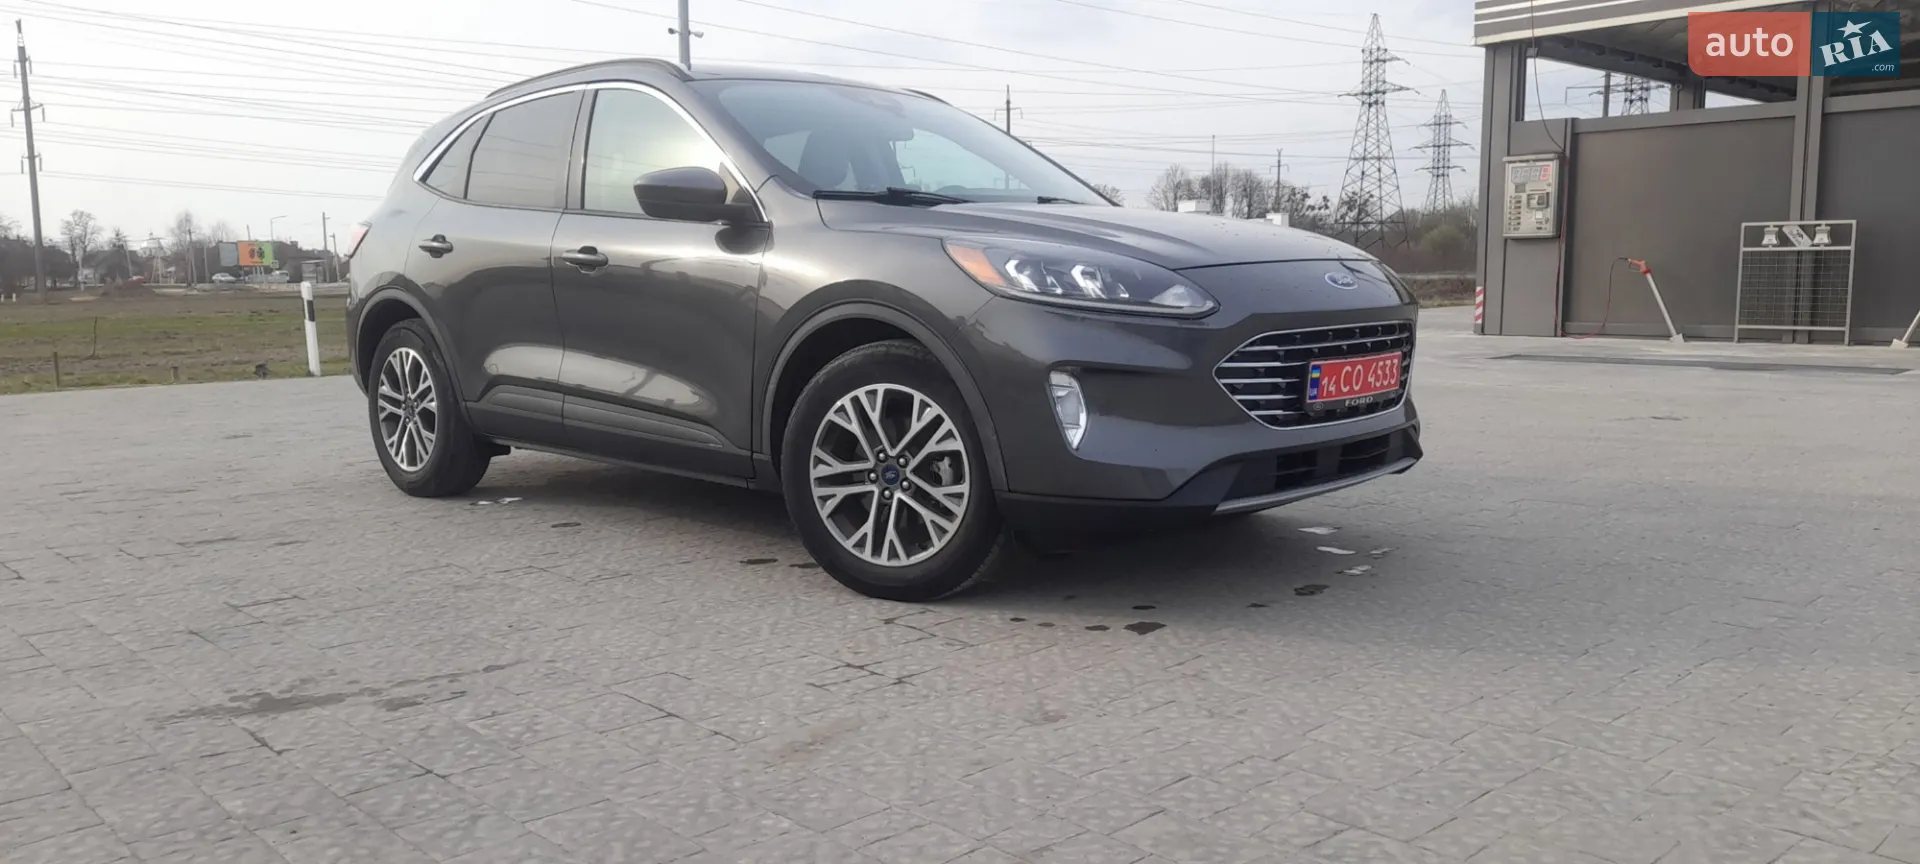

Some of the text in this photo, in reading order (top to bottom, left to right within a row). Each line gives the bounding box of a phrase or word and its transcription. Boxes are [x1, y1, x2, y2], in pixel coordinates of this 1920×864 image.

[1322, 376, 1336, 396] 14
[1341, 365, 1363, 392] CO
[1368, 359, 1398, 388] 4533
[1345, 396, 1373, 407] FORD
